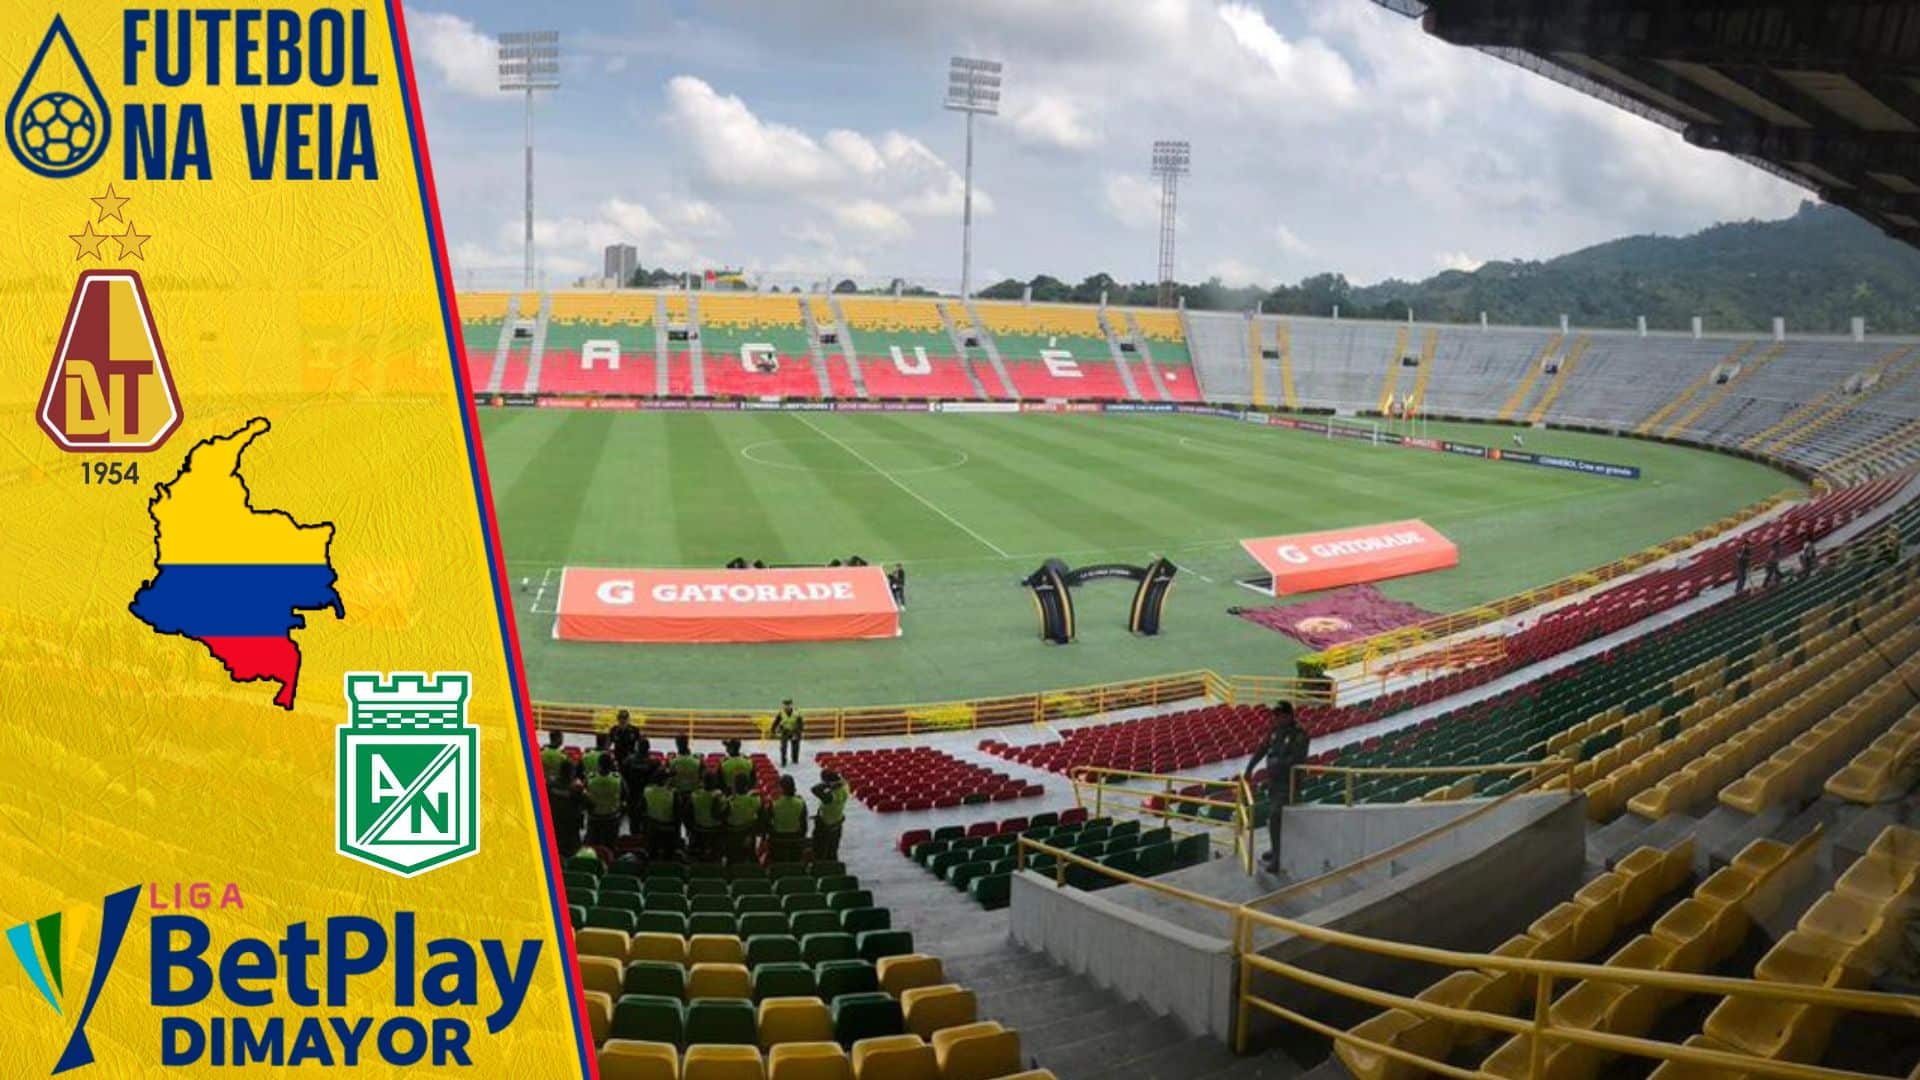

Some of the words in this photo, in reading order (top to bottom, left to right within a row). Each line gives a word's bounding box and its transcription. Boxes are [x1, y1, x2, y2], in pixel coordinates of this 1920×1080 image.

[1278, 545, 1309, 564] G
[1311, 531, 1424, 558] GATORADE
[597, 580, 635, 604] G
[653, 582, 854, 604] GATORADE
